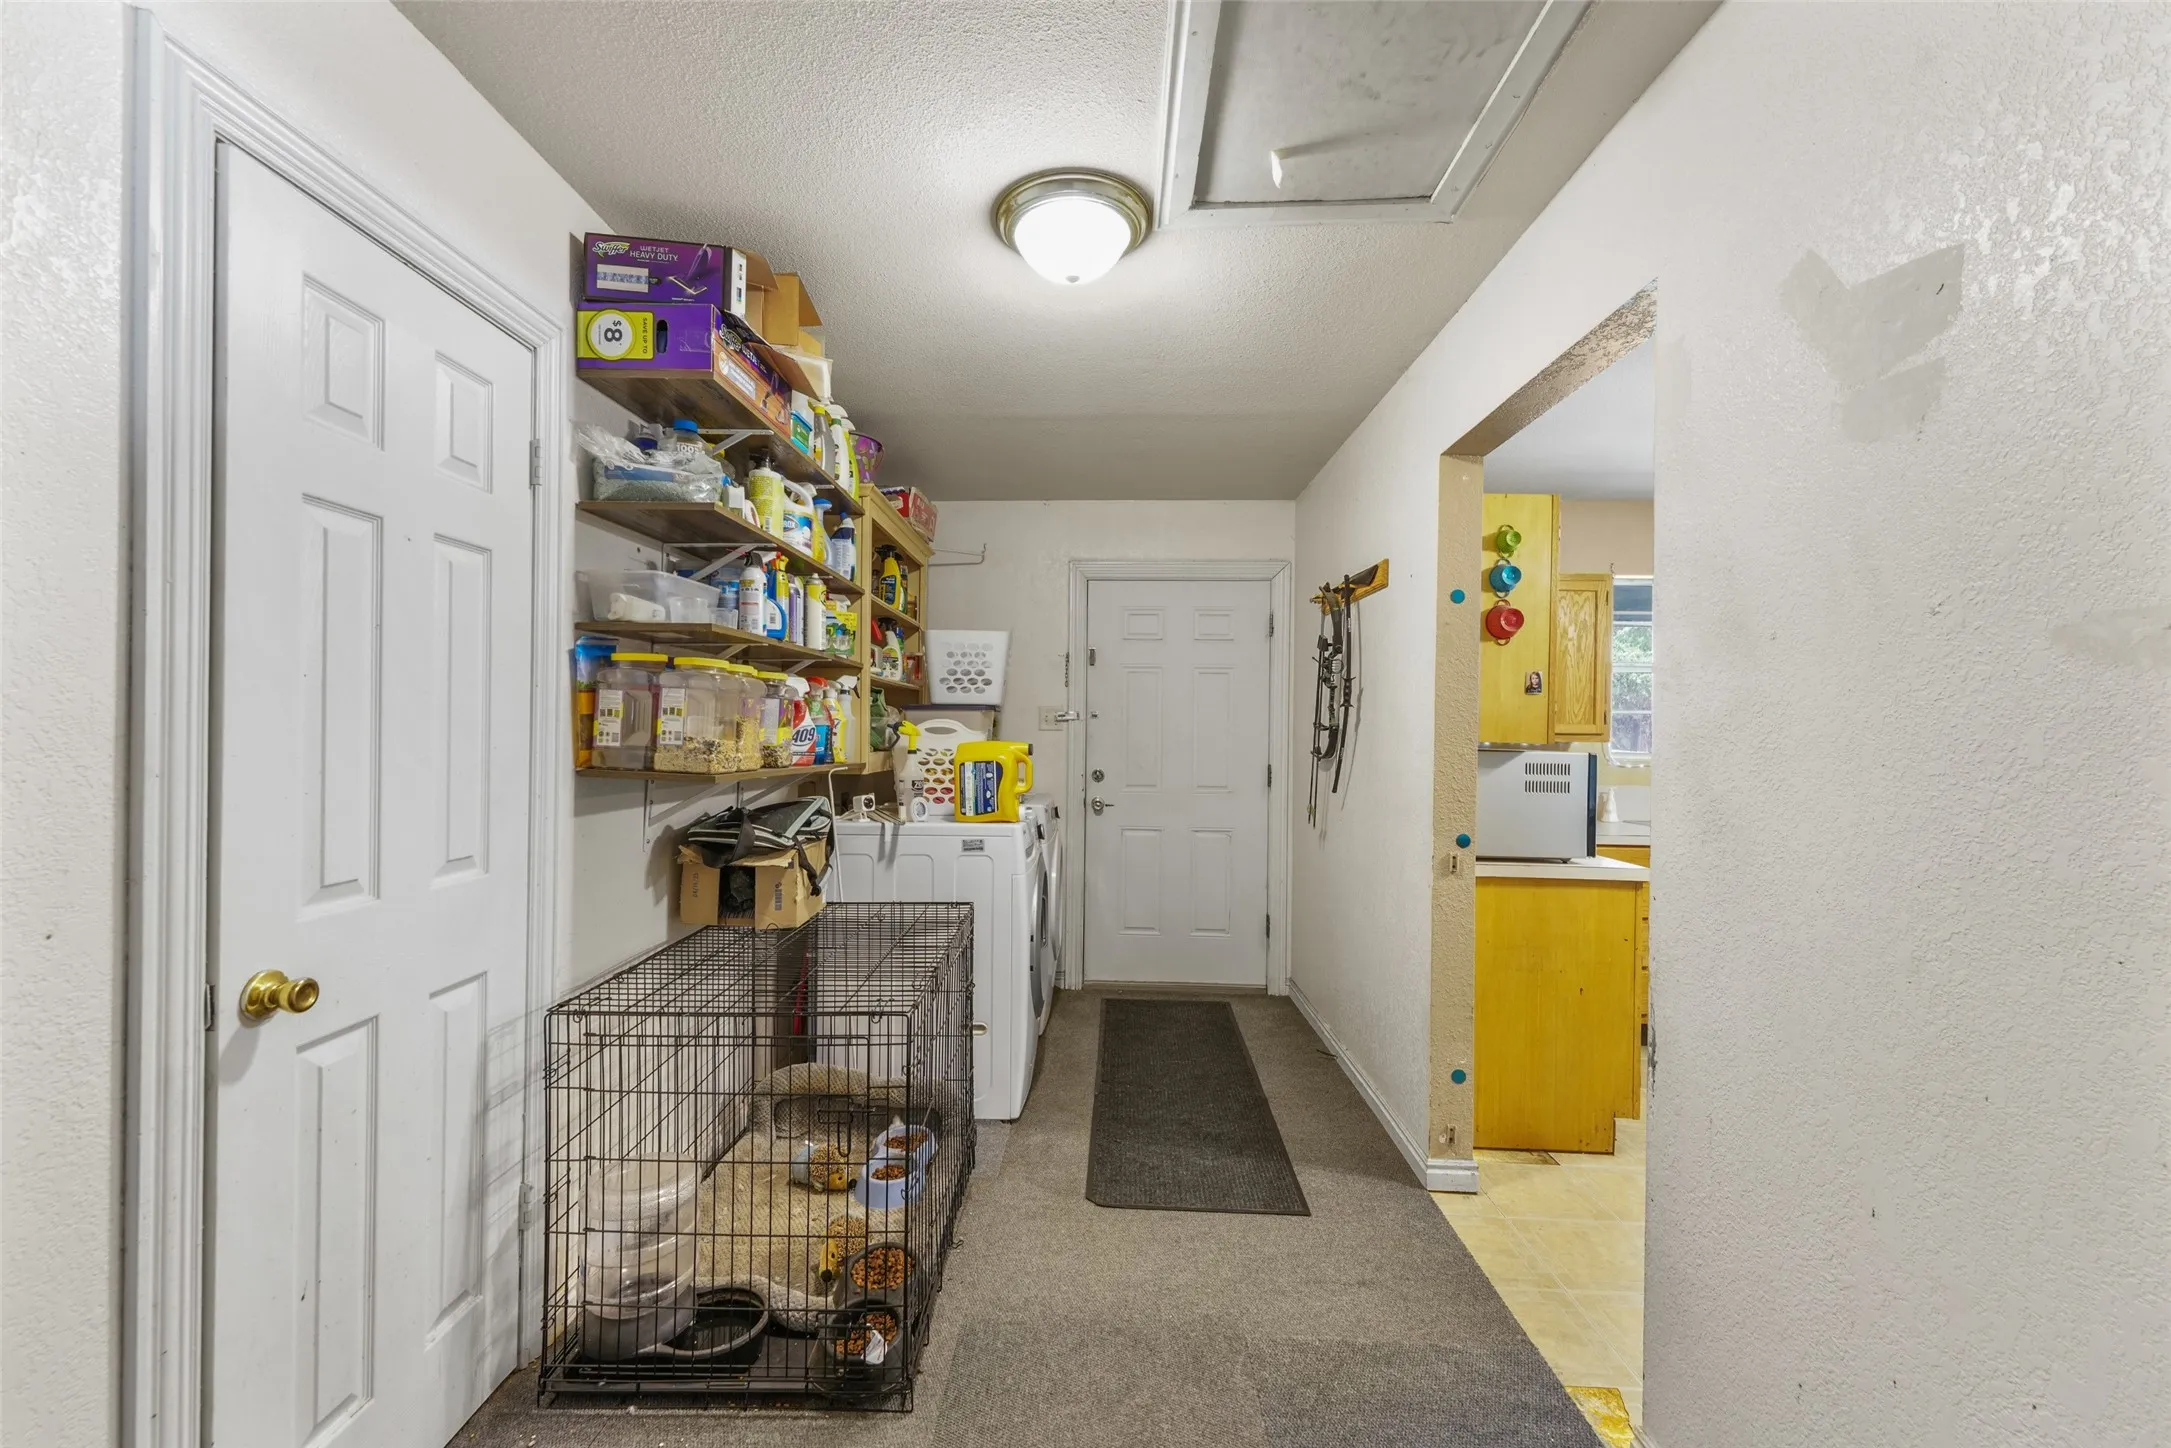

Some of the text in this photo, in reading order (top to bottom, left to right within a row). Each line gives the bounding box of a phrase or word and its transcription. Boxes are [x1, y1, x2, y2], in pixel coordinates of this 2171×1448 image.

[592, 241, 630, 255] Swiffer
[640, 245, 669, 253] WETJET
[629, 250, 656, 259] HEAVY
[657, 253, 679, 261] DUTY
[642, 335, 648, 344] UP
[642, 345, 648, 354] TO
[792, 727, 816, 743] 409
